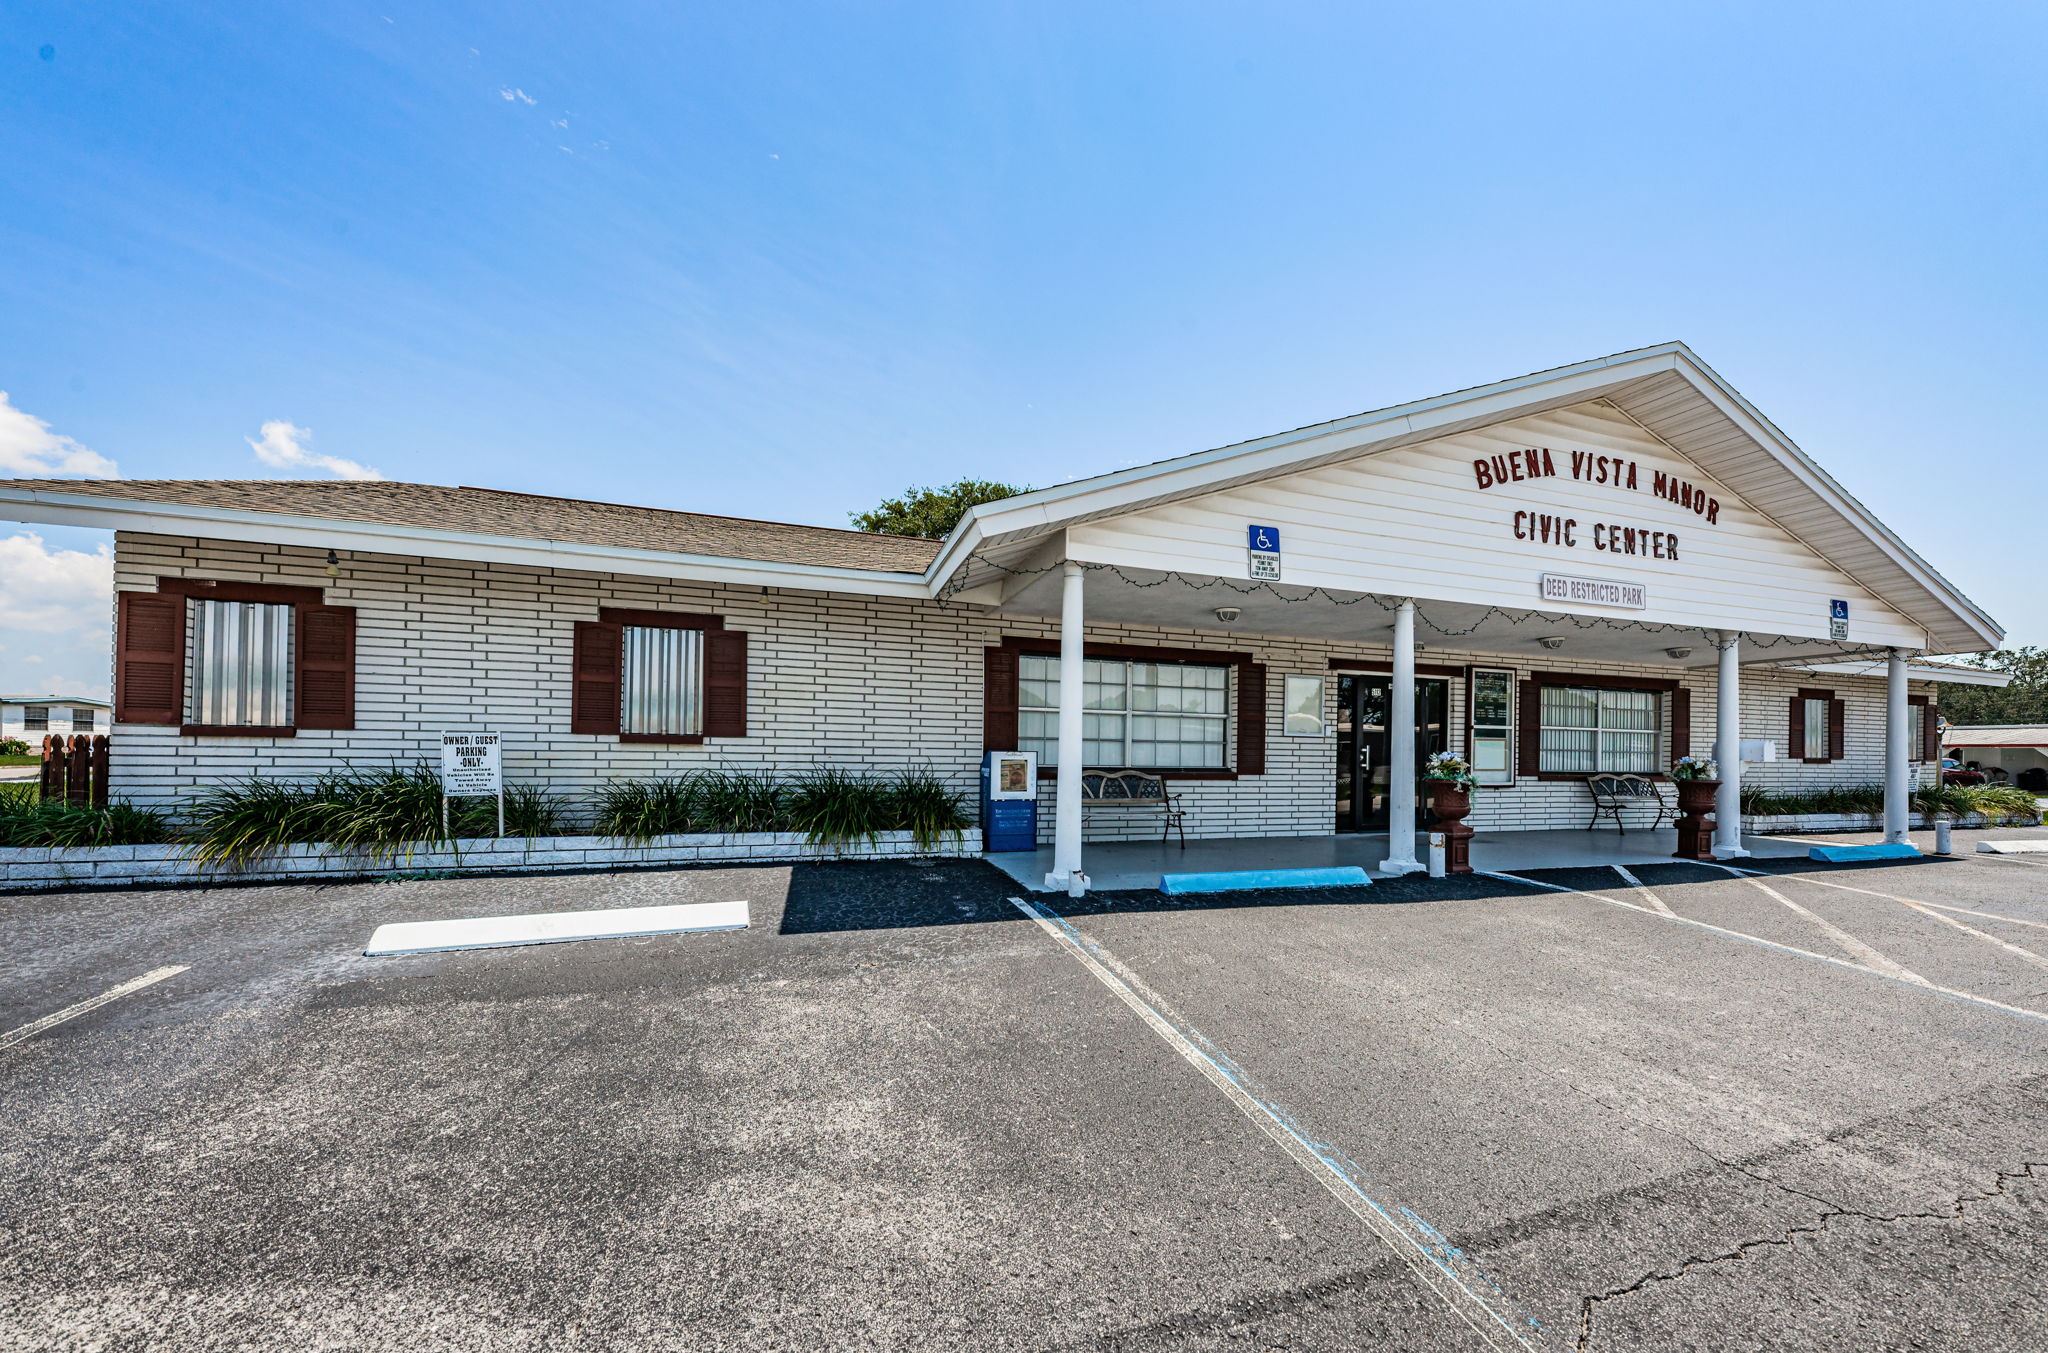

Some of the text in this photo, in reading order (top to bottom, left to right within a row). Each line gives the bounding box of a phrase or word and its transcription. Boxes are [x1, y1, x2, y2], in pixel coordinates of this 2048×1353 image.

[1474, 448, 1720, 525] BUENA VISTA MANOR
[1514, 510, 1679, 561] CIVIC CENTER
[1547, 578, 1642, 606] DEED RESTRICTED PARK
[444, 736, 469, 745] OWNER
[475, 736, 498, 745] GUEST
[456, 747, 487, 756] PARKING
